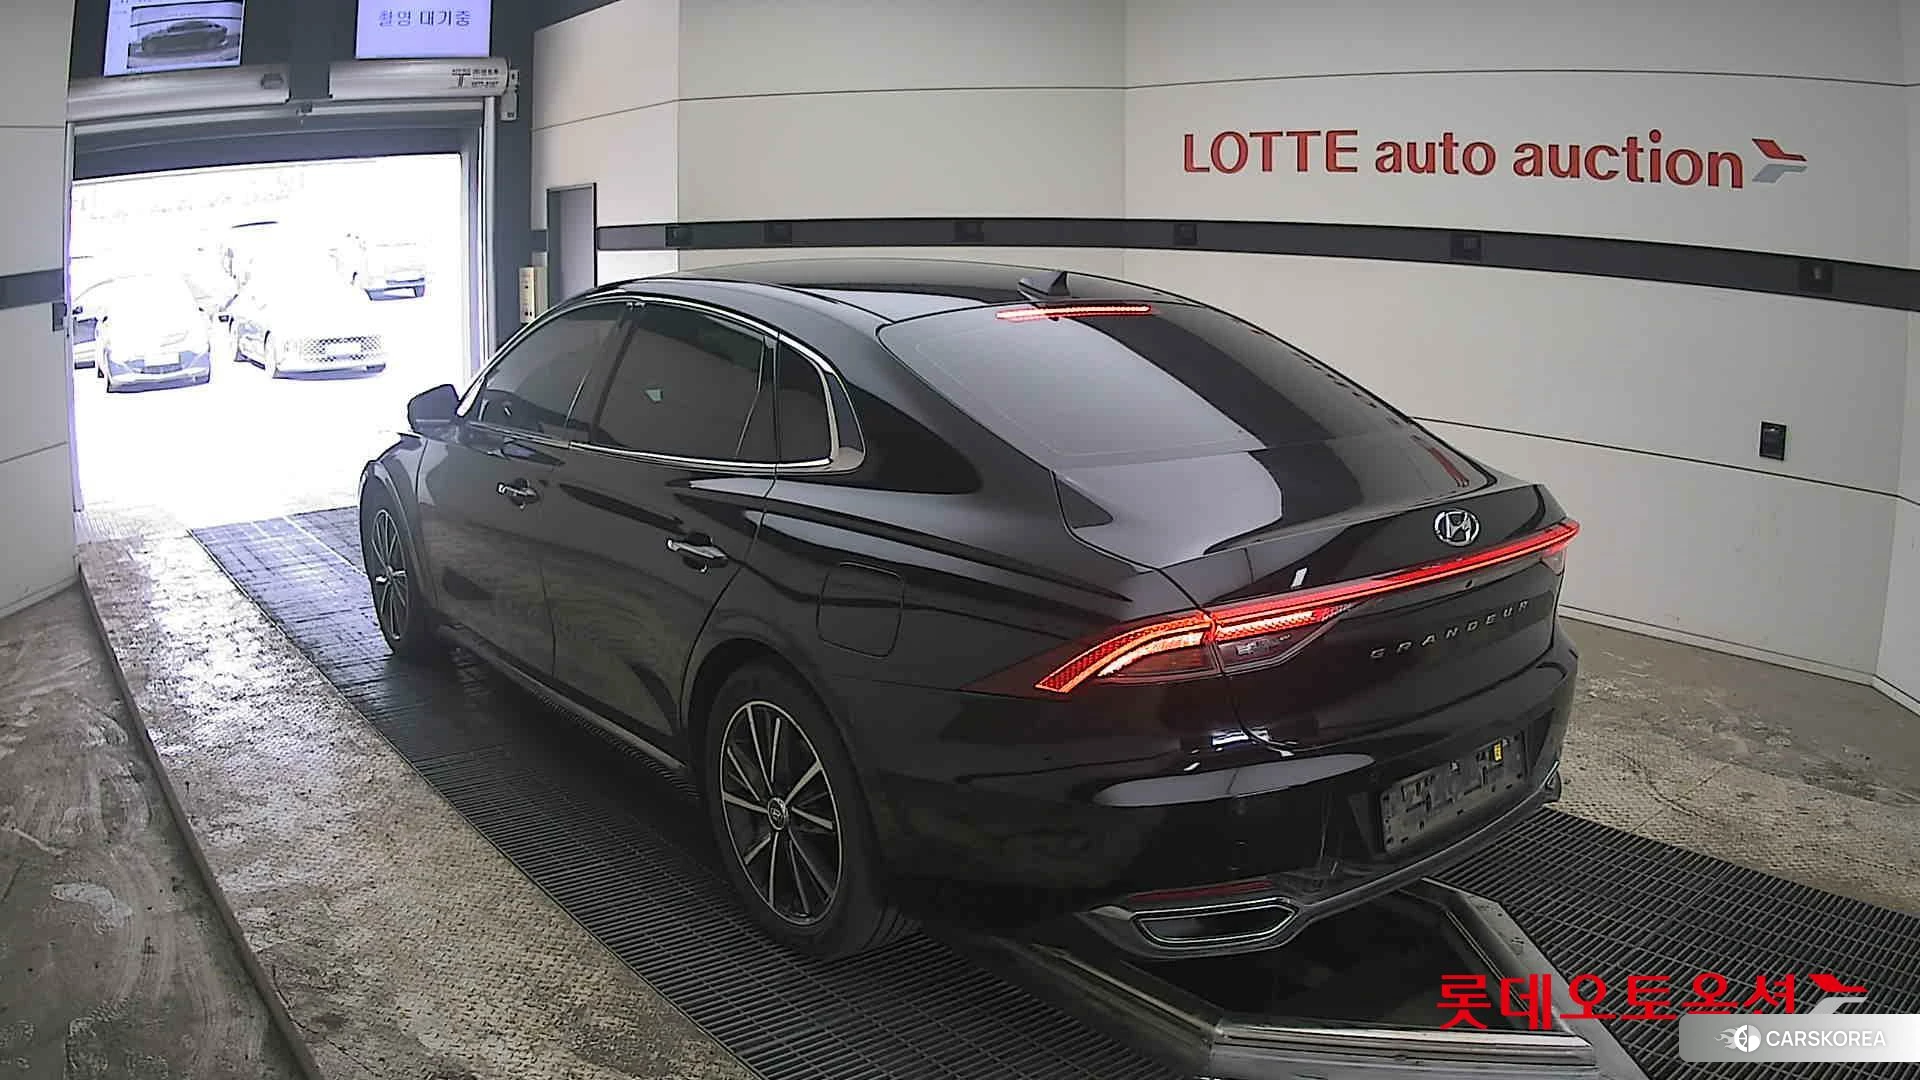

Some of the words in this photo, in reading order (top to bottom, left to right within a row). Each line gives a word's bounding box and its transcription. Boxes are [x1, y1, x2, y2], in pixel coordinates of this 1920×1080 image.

[420, 10, 471, 26] 대기중
[1183, 130, 1358, 174] LOTTE
[1376, 132, 1497, 176] auto
[1512, 130, 1745, 189] auction
[1369, 600, 1530, 660] GRANDEUR
